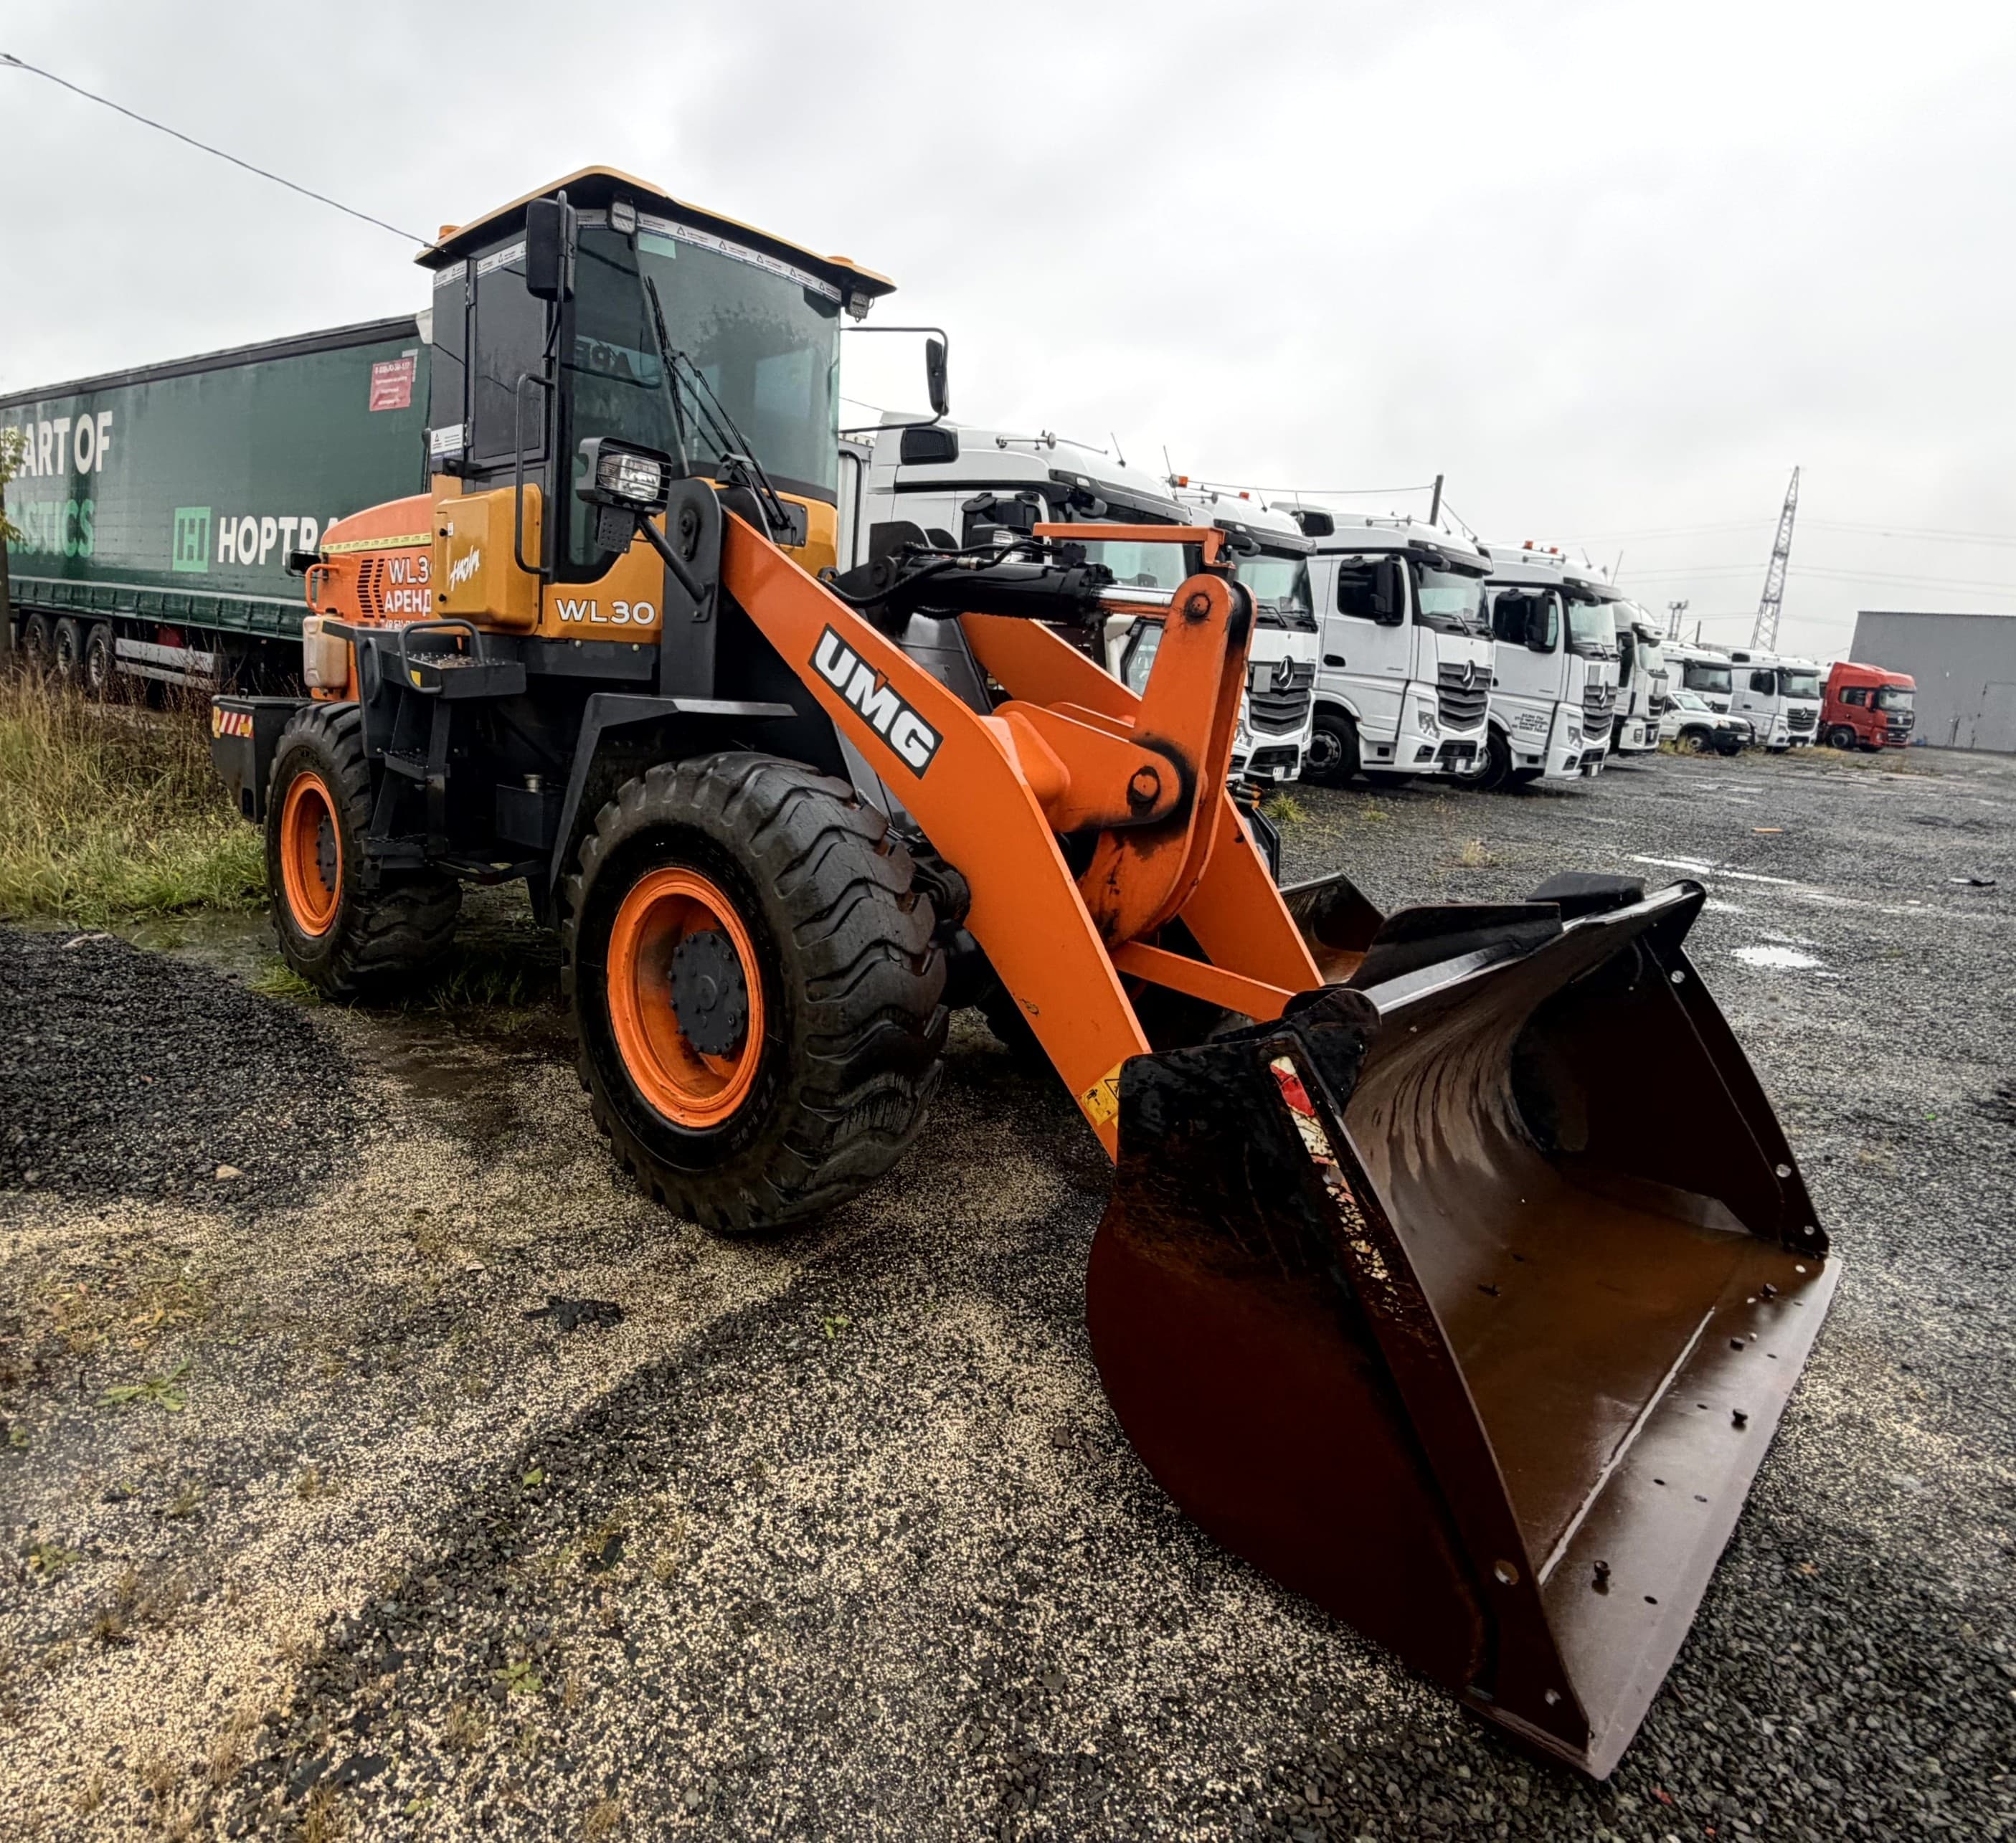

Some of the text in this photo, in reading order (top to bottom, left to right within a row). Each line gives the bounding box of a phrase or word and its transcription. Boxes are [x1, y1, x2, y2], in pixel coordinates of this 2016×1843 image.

[75, 411, 113, 475] OF
[217, 516, 339, 566] HOPTR
[388, 555, 432, 584] WL3
[555, 598, 656, 625] WL30
[815, 630, 934, 768] UMG
